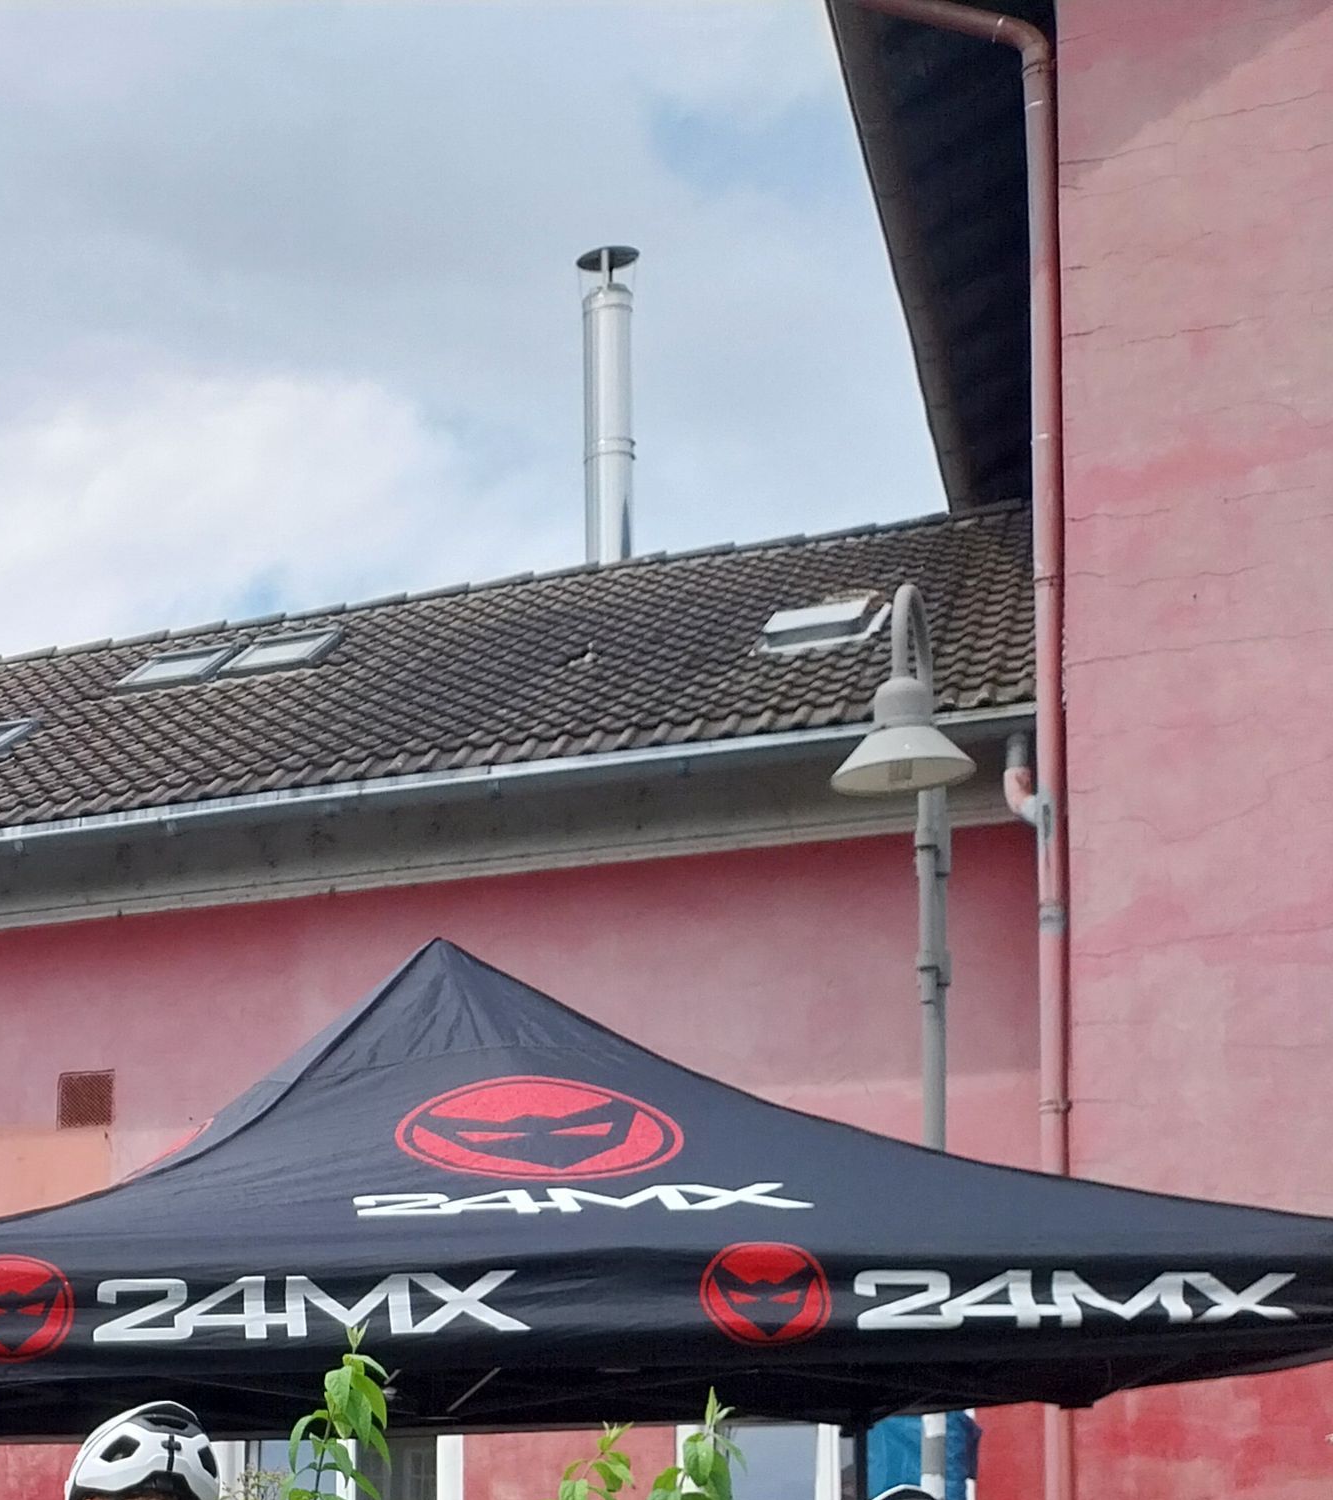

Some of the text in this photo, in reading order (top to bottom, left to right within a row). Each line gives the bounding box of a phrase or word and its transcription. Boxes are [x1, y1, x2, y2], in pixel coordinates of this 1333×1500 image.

[352, 1182, 814, 1217] 24MX
[92, 1270, 531, 1342] 24MX
[853, 1269, 1299, 1329] 24MX
